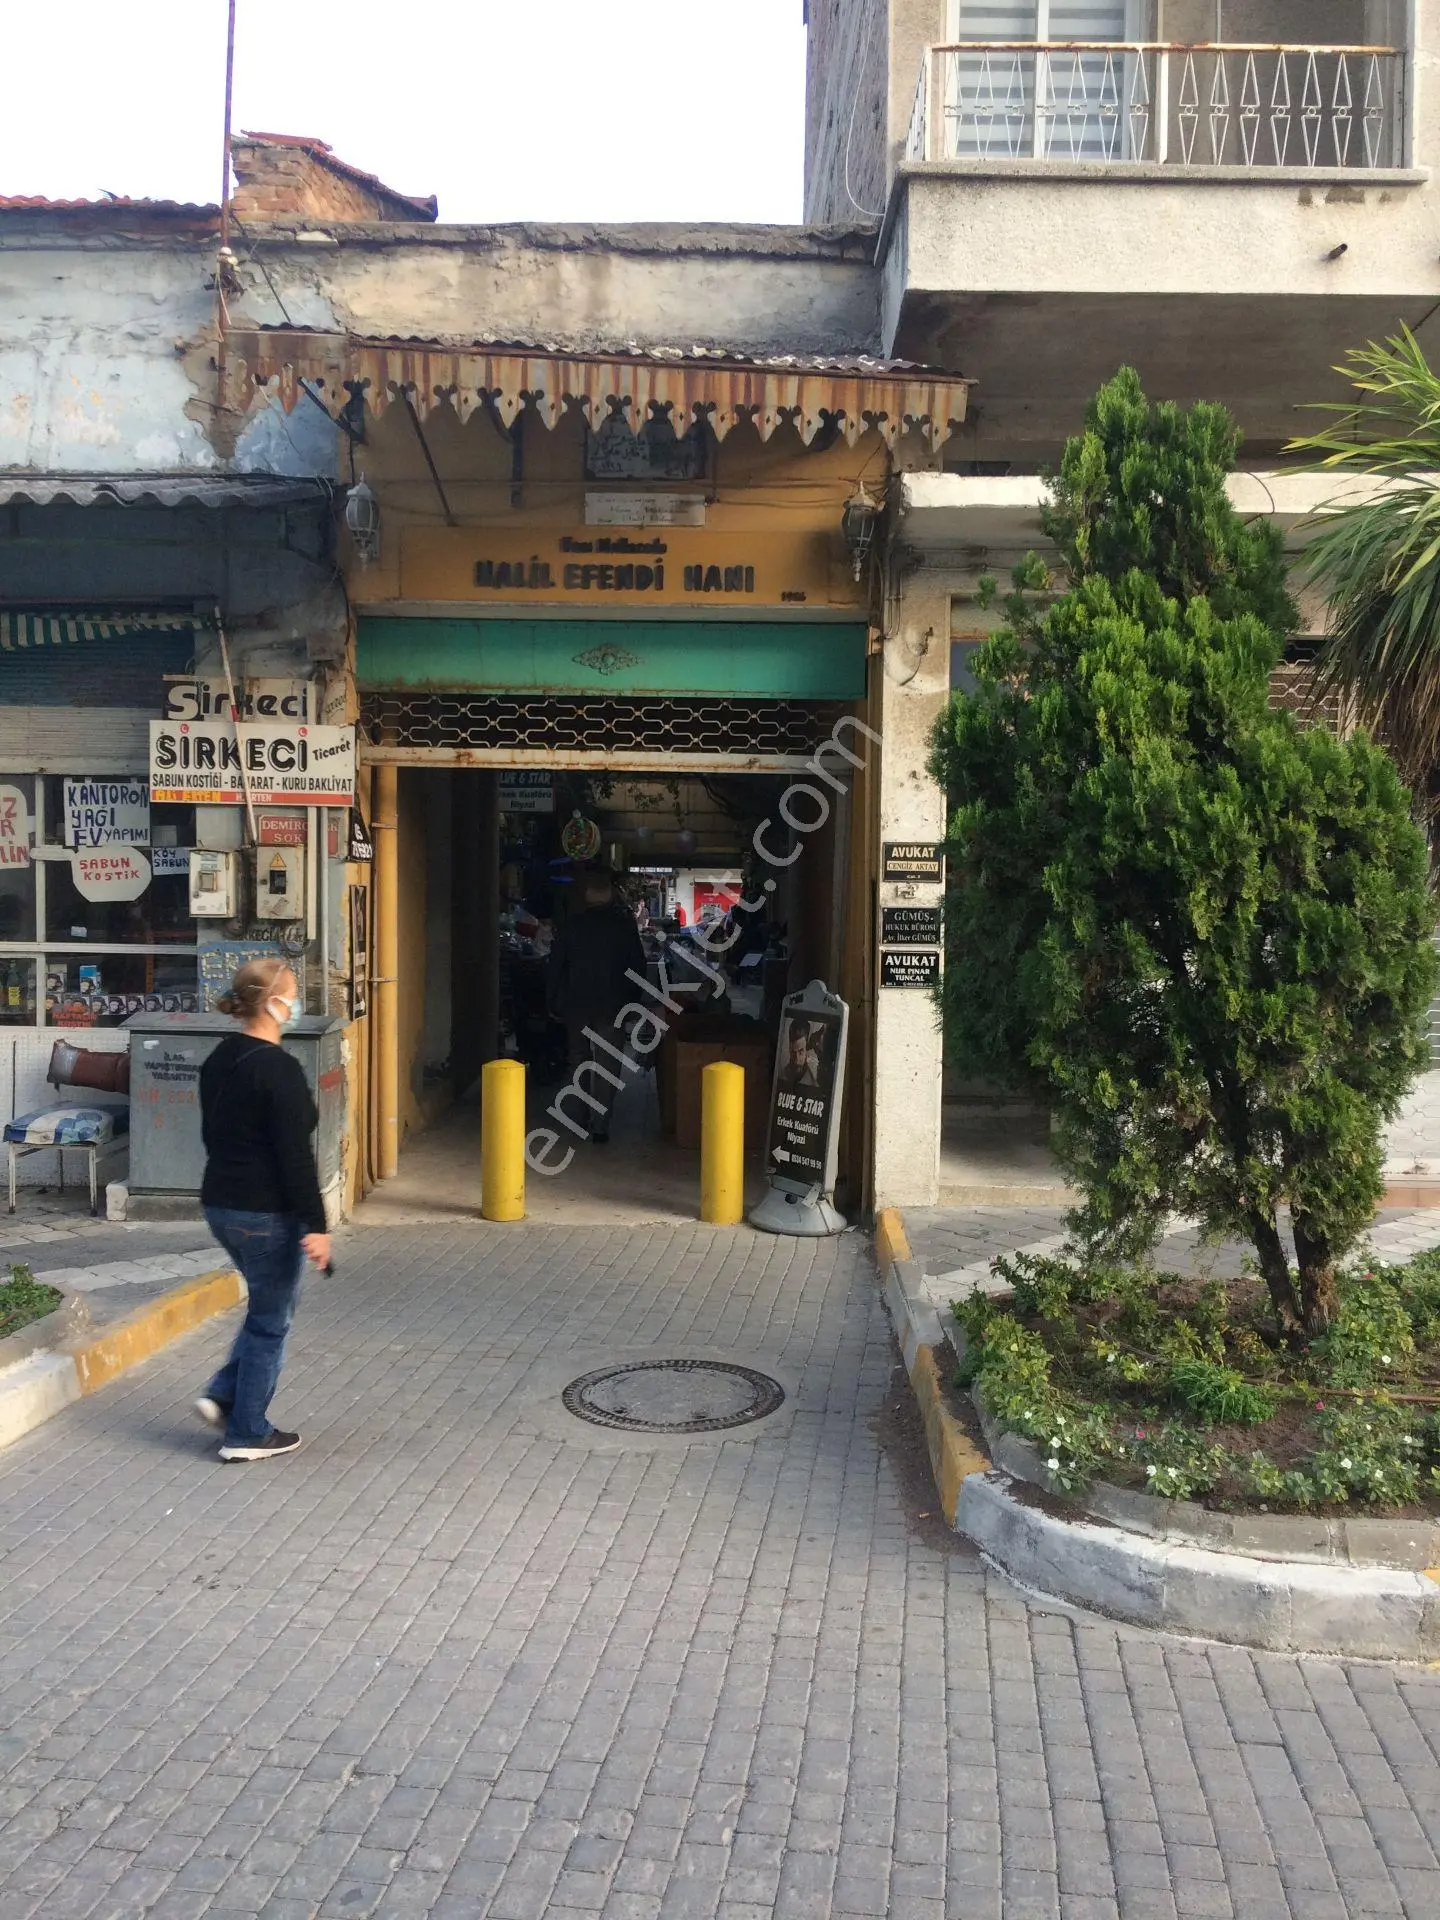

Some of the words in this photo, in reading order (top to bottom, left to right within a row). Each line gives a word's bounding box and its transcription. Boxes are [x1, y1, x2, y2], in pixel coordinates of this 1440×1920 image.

[563, 557, 664, 591] EFENDİ
[684, 564, 755, 593] HANI
[155, 723, 308, 773] SİRKECİ
[312, 740, 351, 761] Ticaret
[152, 773, 184, 788] SABUN
[186, 772, 222, 788] KOSTİĞİ
[282, 777, 306, 791] KURU
[308, 775, 352, 792] BAKLİYAT
[72, 807, 115, 828] YAĞI
[74, 828, 103, 847] EV
[105, 828, 148, 842] YAPIMI
[892, 846, 935, 858] AVUKAT
[80, 858, 130, 869] SABUN
[888, 861, 913, 870] CENGİZ
[916, 863, 937, 871] AKTAY
[885, 923, 910, 931] HUKUK
[885, 955, 936, 967] AVUKAT
[777, 1092, 796, 1109] BLUE
[804, 1099, 824, 1117] STAR
[777, 1116, 793, 1128] Erkek
[787, 1131, 806, 1144] Niyazi
